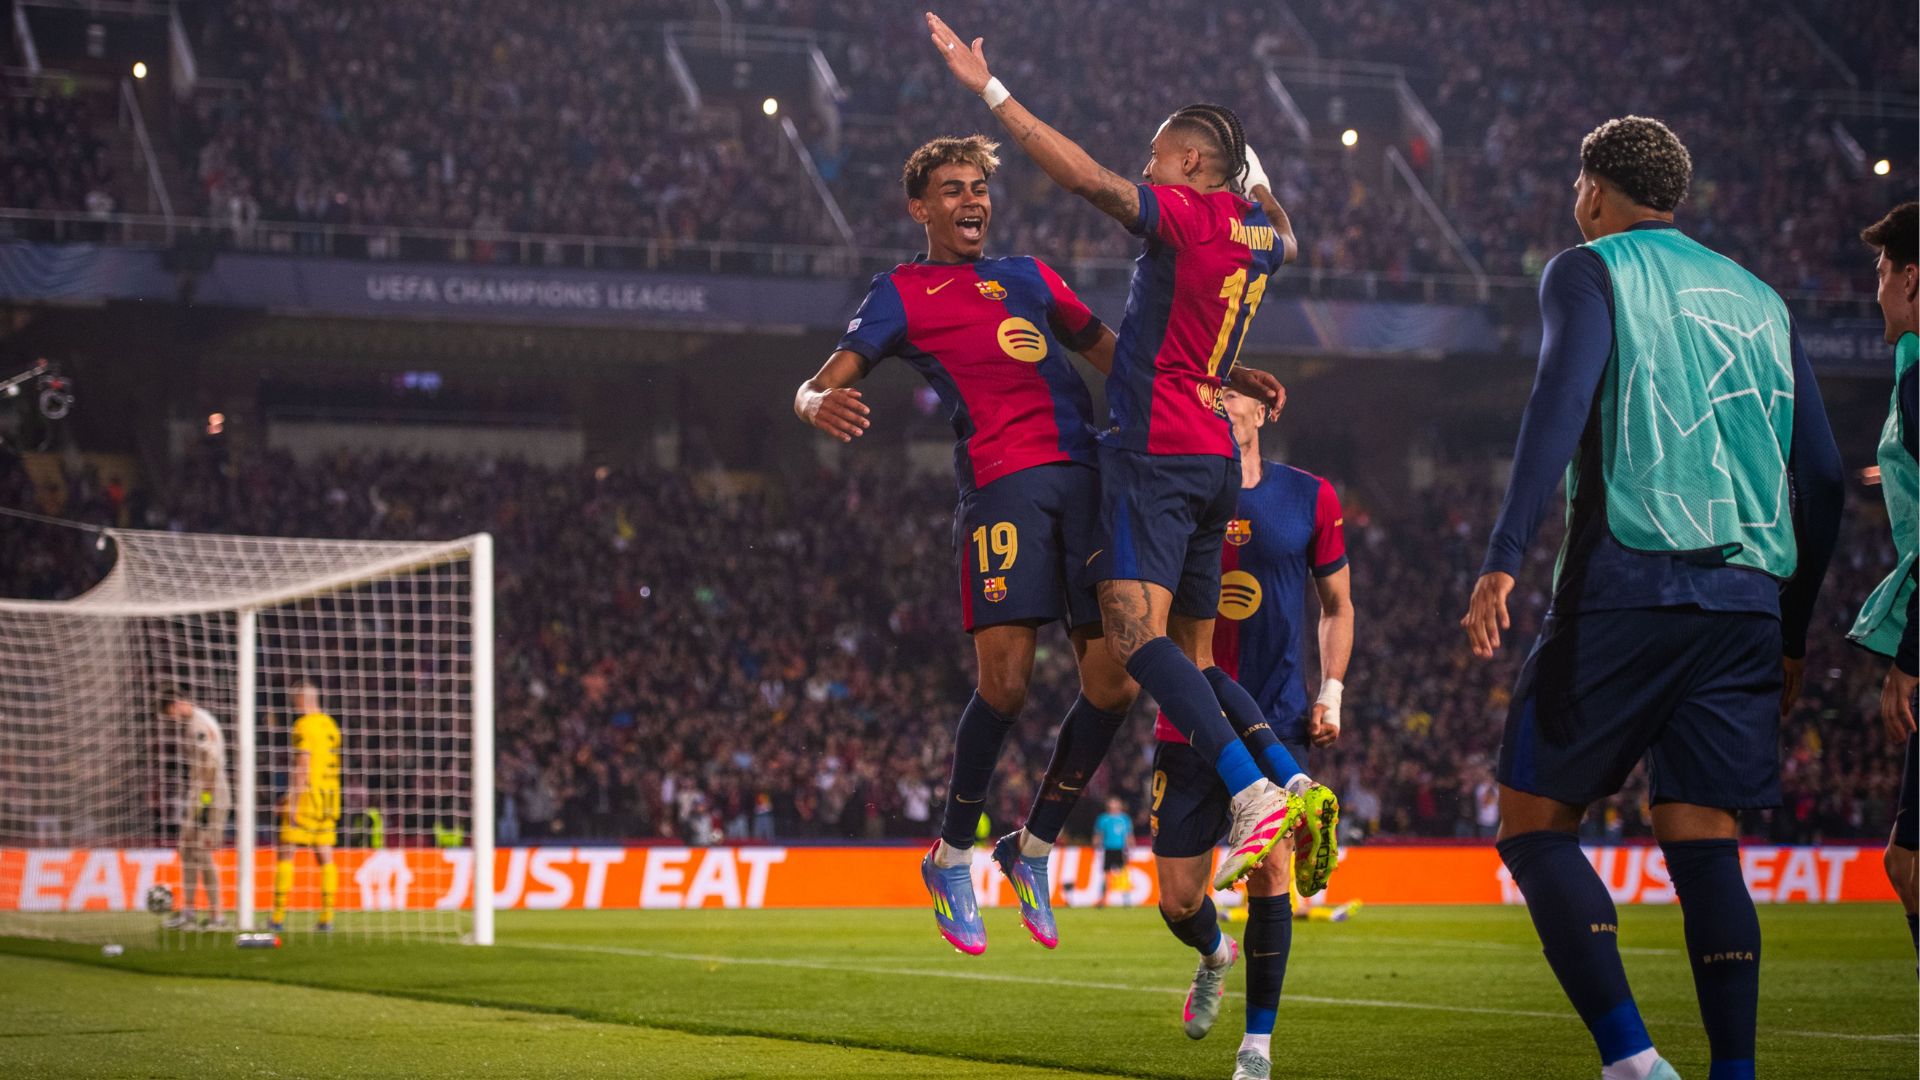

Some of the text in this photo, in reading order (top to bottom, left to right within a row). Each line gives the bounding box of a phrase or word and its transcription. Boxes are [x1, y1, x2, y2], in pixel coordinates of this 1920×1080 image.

[366, 274, 706, 311] UEFA CHAMPIONS LEAGUE
[1207, 268, 1268, 378] 11
[972, 521, 1018, 573] 19
[1152, 770, 1167, 811] 9
[19, 848, 176, 911] EAT
[435, 847, 787, 909] JUST EAT
[1740, 847, 1859, 904] EAT
